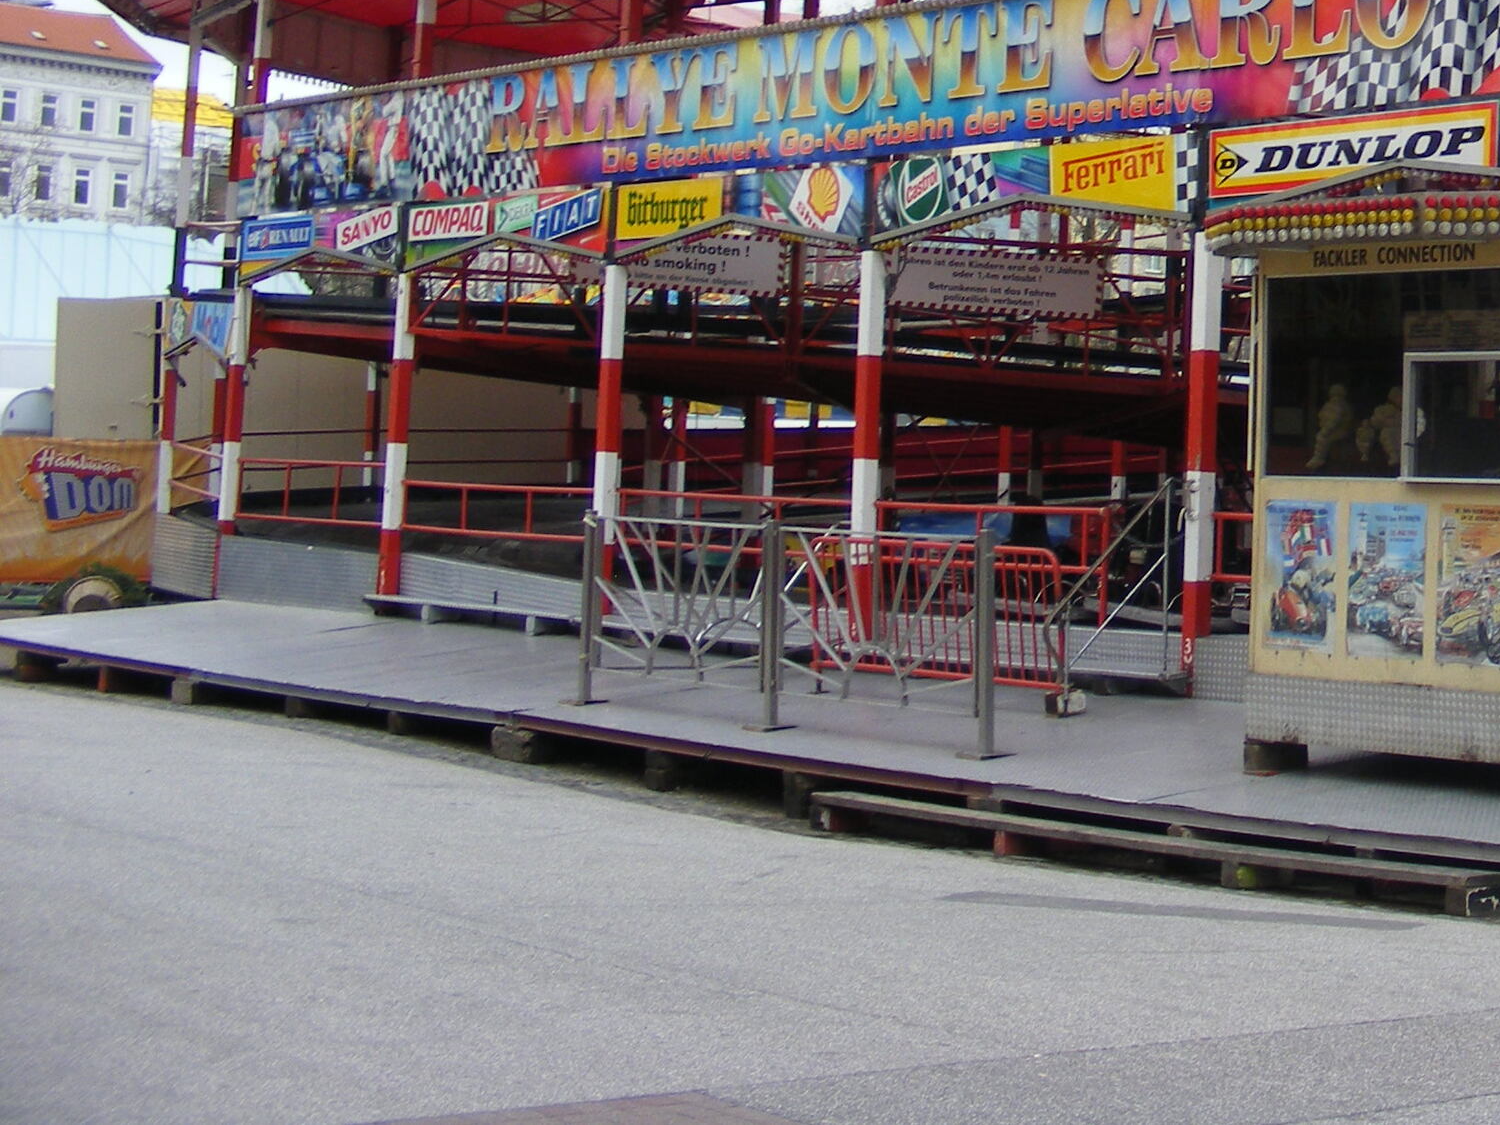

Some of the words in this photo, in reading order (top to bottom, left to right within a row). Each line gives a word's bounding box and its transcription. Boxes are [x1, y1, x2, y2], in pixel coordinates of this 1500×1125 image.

[486, 41, 738, 154] RALLYE
[602, 146, 638, 174] Die
[645, 132, 771, 171] Stockwerk
[778, 111, 954, 157] Go-Kartbahn
[964, 105, 1015, 137] der
[1024, 82, 1214, 132] Superlative
[1254, 125, 1485, 173] DUNLOP
[1060, 141, 1165, 193] Ferrari
[905, 171, 939, 203] Castrol
[340, 211, 392, 246] SANYO
[411, 205, 484, 237] COMPAQ
[536, 194, 599, 240] FIAT
[674, 242, 741, 257] verboten
[1312, 249, 1368, 269] FACKLER
[1376, 243, 1476, 266] CONNECTION
[654, 257, 717, 275] smoking
[948, 259, 966, 267] den
[968, 260, 1005, 271] Kindern
[1057, 266, 1090, 276] Jahren
[1023, 288, 1057, 298] Fahren
